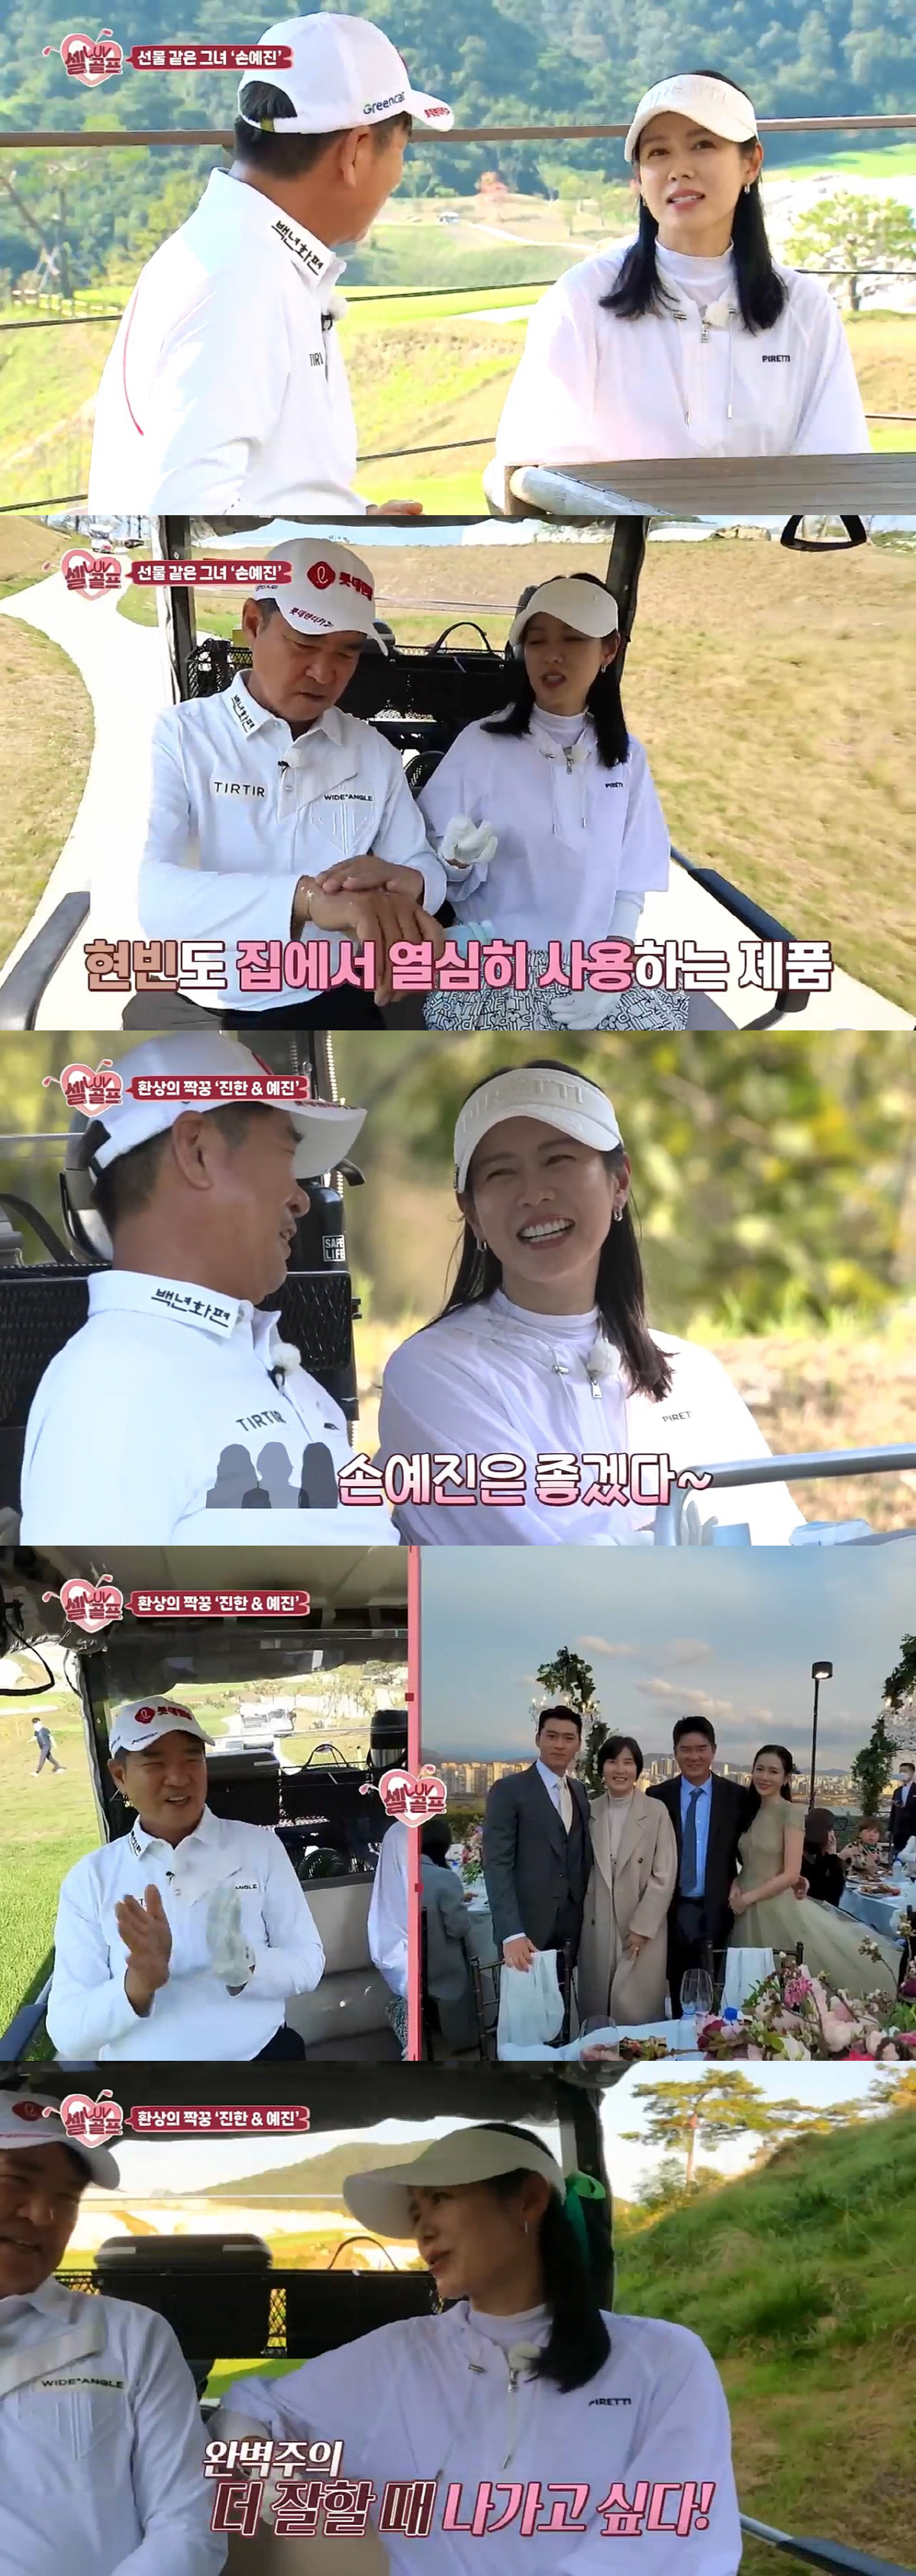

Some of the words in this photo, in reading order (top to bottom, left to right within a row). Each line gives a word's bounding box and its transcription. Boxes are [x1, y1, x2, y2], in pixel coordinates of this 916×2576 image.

[363, 92, 405, 114] Greencar
[271, 221, 324, 276] 백년화편
[214, 782, 265, 798] TIRTIR
[325, 1237, 344, 1249] SAFE
[326, 1249, 344, 1259] LIFE
[151, 1288, 231, 1328] 백년화편
